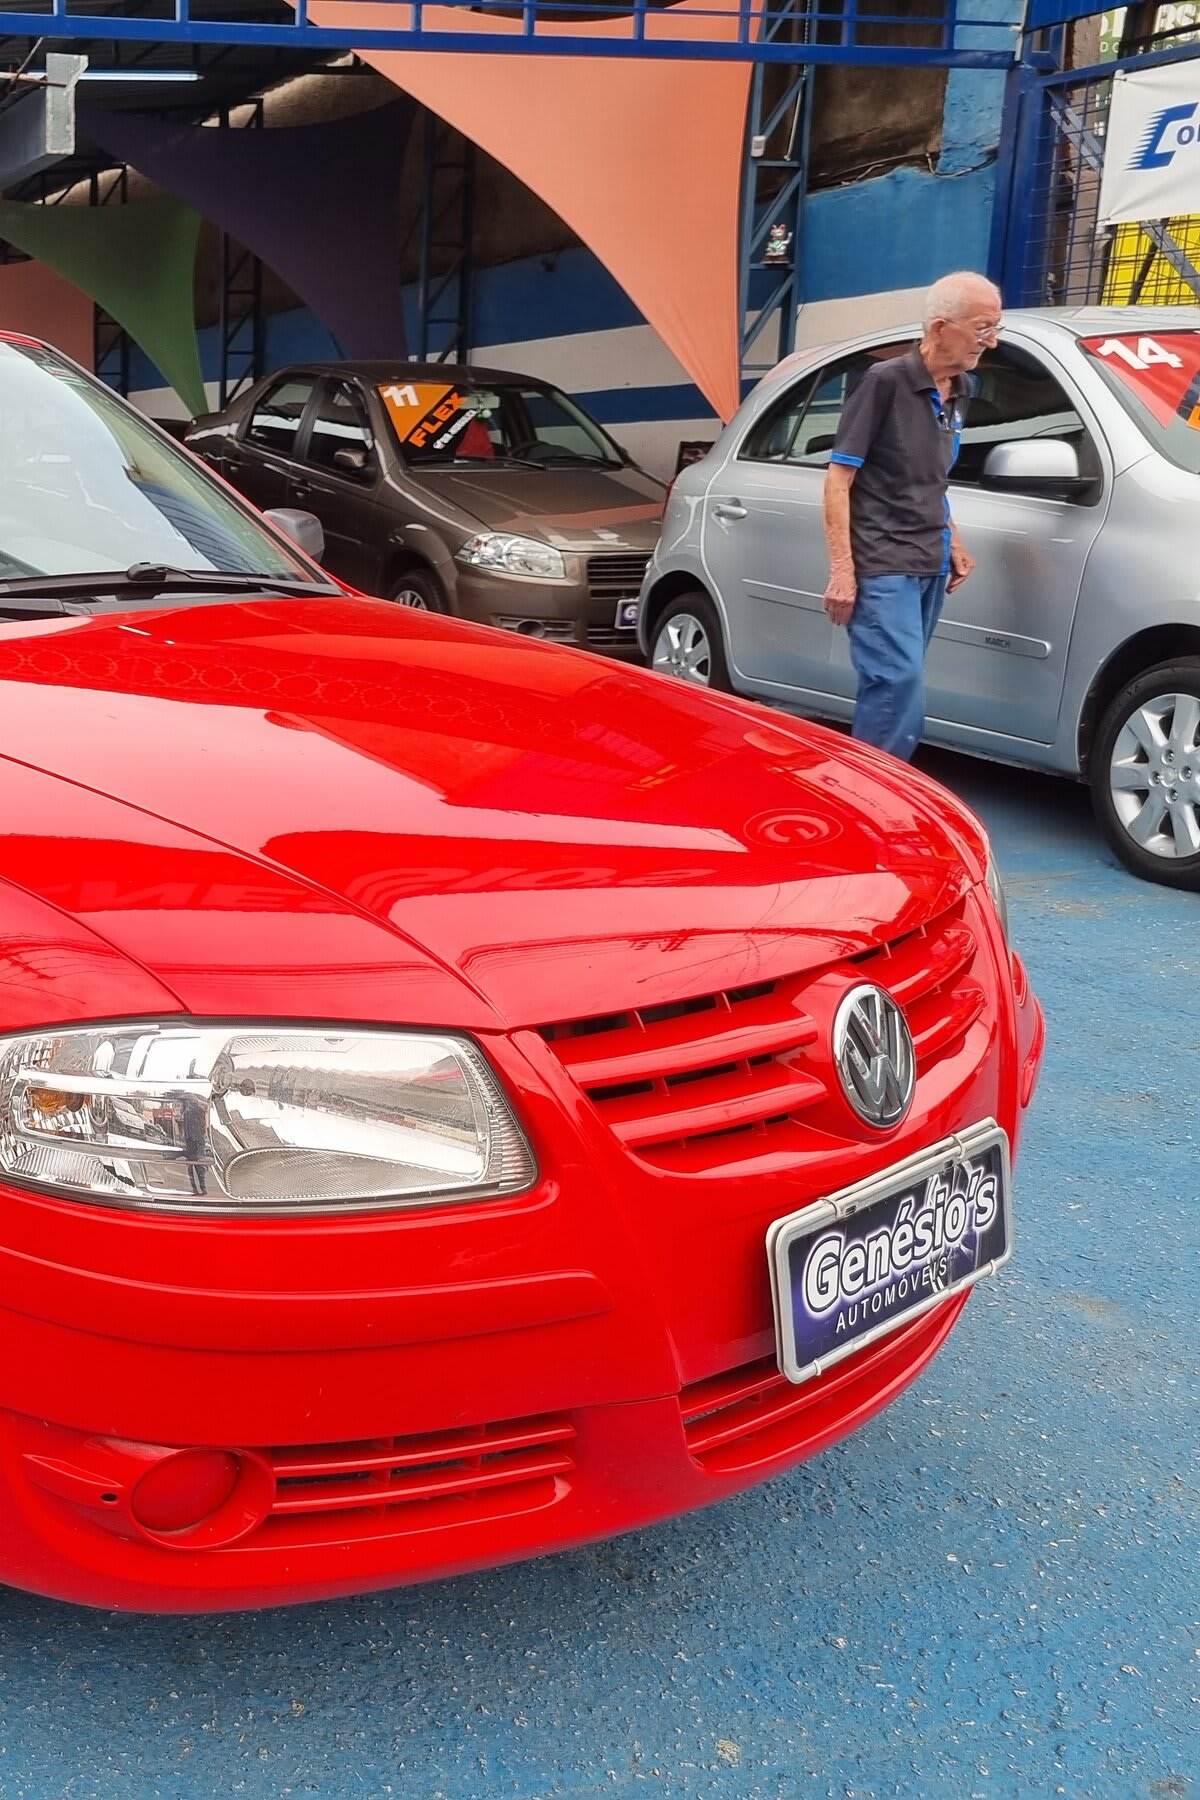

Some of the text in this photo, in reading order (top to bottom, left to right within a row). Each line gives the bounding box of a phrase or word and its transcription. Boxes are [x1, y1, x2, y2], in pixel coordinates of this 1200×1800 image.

[1097, 337, 1185, 371] 14
[382, 384, 420, 408] 11
[408, 392, 469, 448] FLEX
[804, 1167, 998, 1313] Genésio's
[835, 1256, 948, 1334] AUTOMÓVEIS
